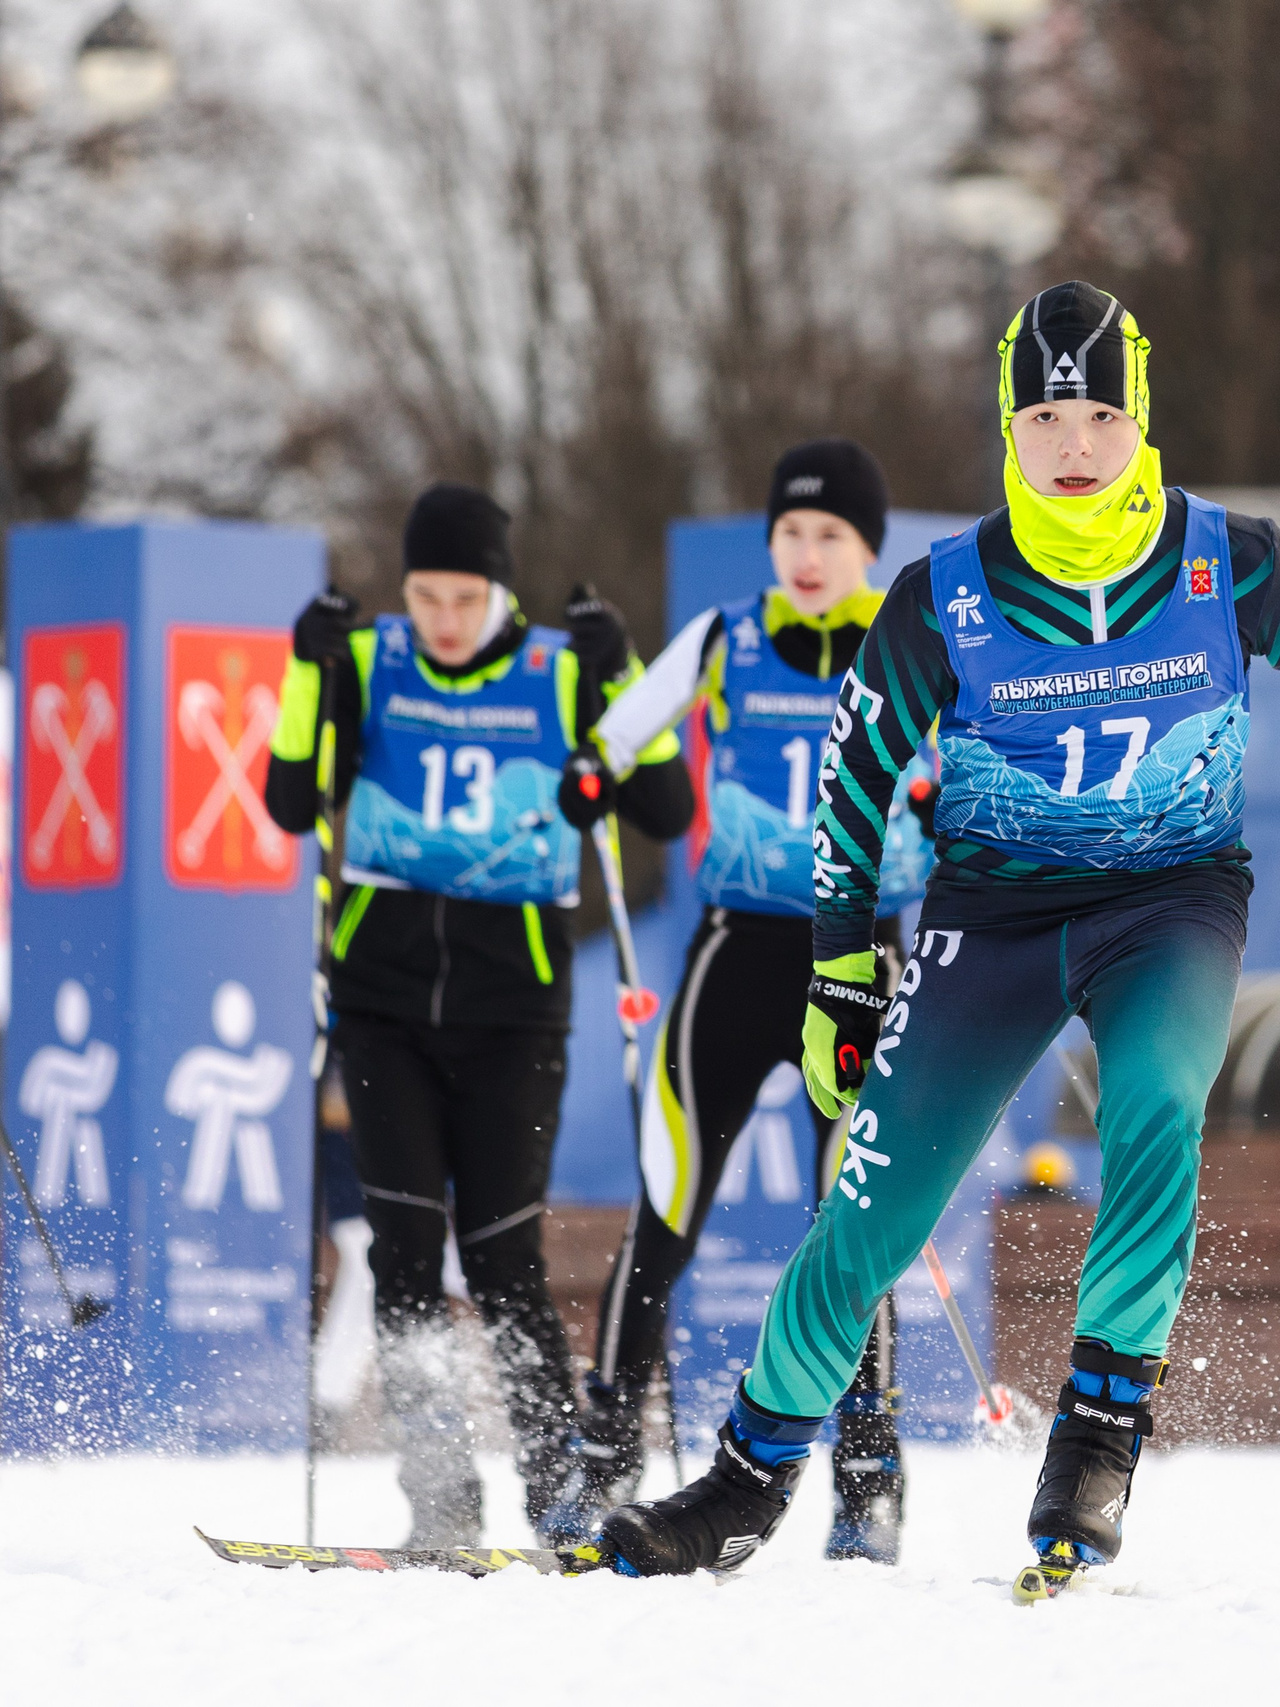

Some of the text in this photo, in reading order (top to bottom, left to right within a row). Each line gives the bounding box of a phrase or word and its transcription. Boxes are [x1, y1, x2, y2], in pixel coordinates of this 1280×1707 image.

[1044, 384, 1088, 392] FISCHER
[993, 655, 1204, 700] ЛЫЖНЫЕ ГОНКИ
[993, 700, 1004, 711] НА
[1039, 690, 1110, 710] ГУБЕРНАТОРА
[1113, 673, 1210, 701] САНКТ-ПЕТЕРБУРГА
[1056, 716, 1150, 800] 17
[419, 743, 495, 834] 13
[781, 736, 830, 829] 1
[823, 983, 888, 1010] ATOMIC
[838, 1100, 891, 1210] ski
[1073, 1402, 1135, 1429] SPINE
[722, 1439, 773, 1485] SPINE
[222, 1540, 337, 1562] FISCHER
